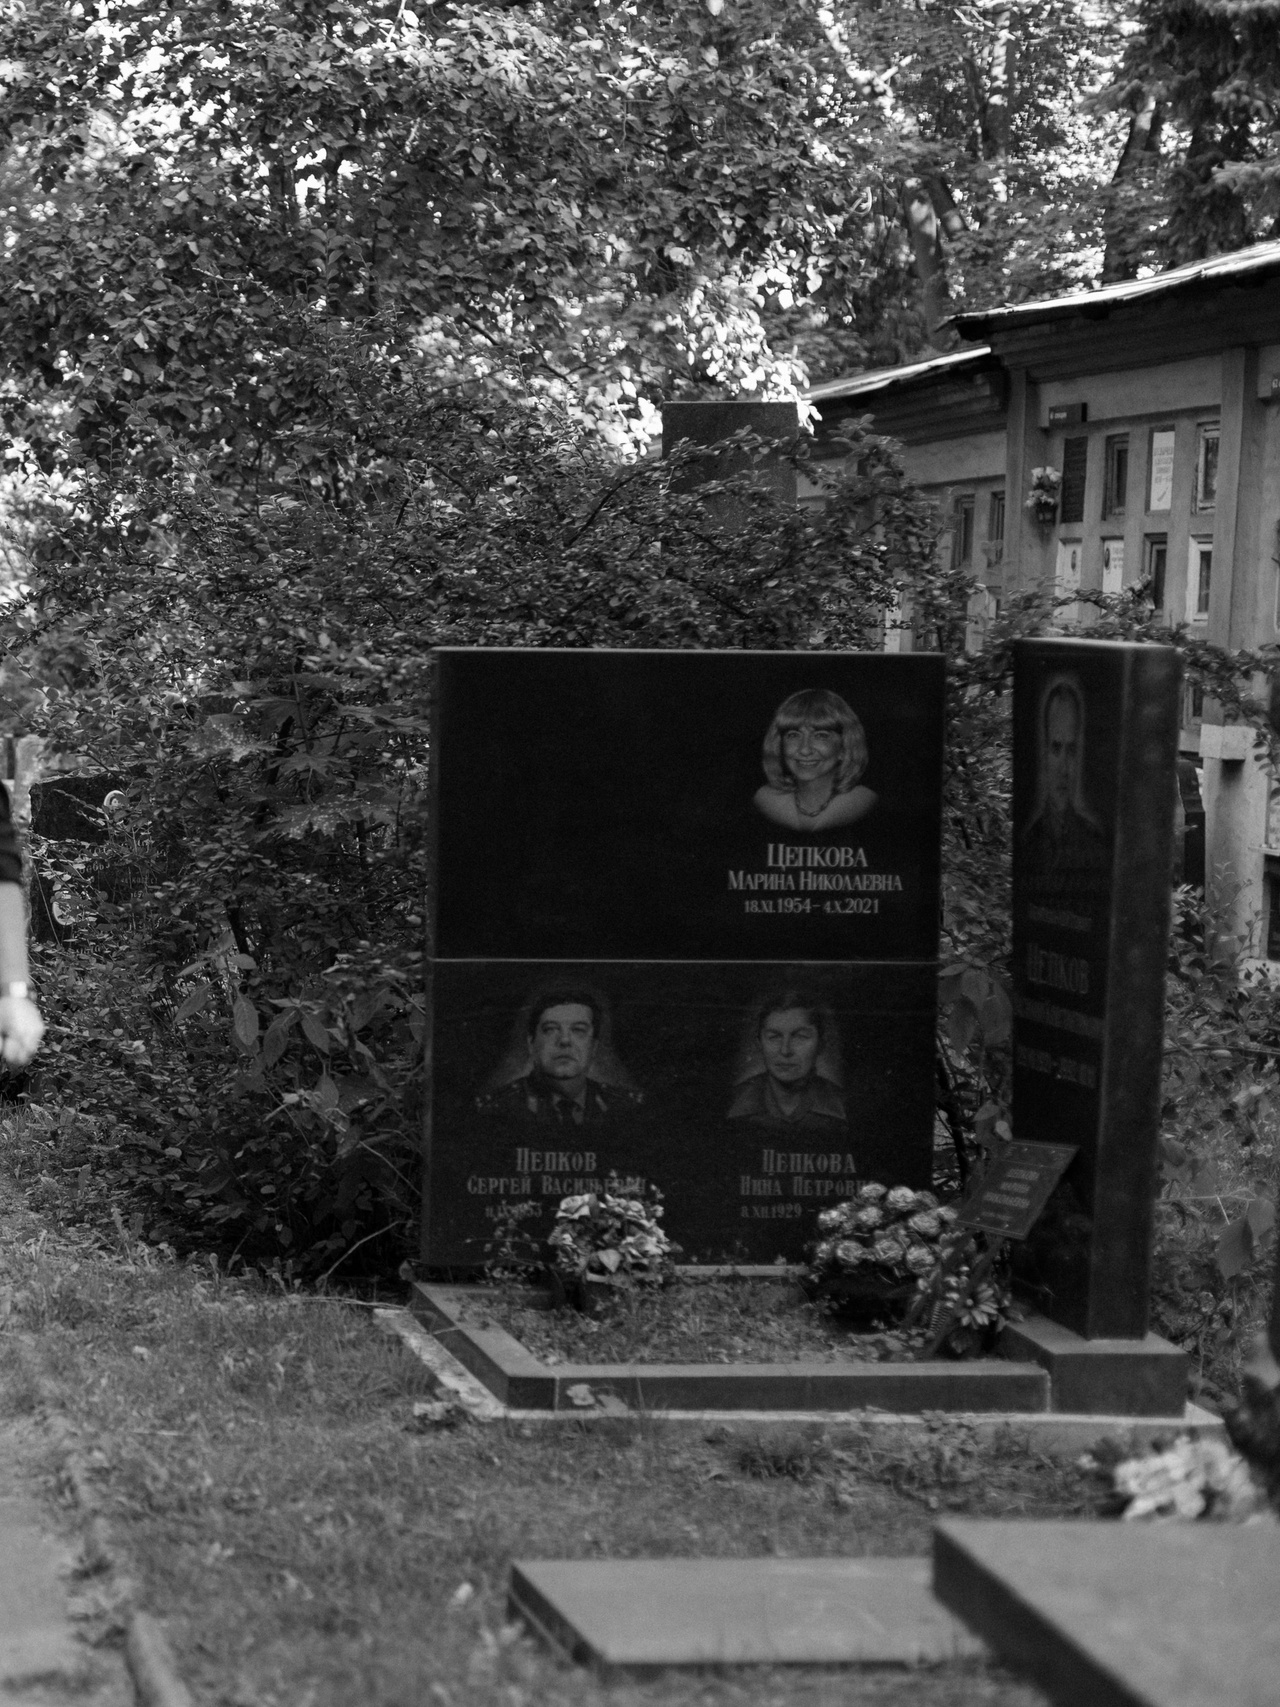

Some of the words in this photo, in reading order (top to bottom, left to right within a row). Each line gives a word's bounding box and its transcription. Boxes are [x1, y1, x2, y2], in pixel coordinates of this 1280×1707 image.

[768, 843, 868, 872] ЦЕПКОВА
[728, 870, 795, 891] МАРИНА
[799, 871, 903, 891] НИКОЛАЕВНА
[516, 1147, 597, 1175] ЦЕПКОВ
[762, 1149, 856, 1176] ЦЕПКОВА
[466, 1174, 532, 1195] СЕРГЕЙ
[740, 1175, 783, 1196] НИНА
